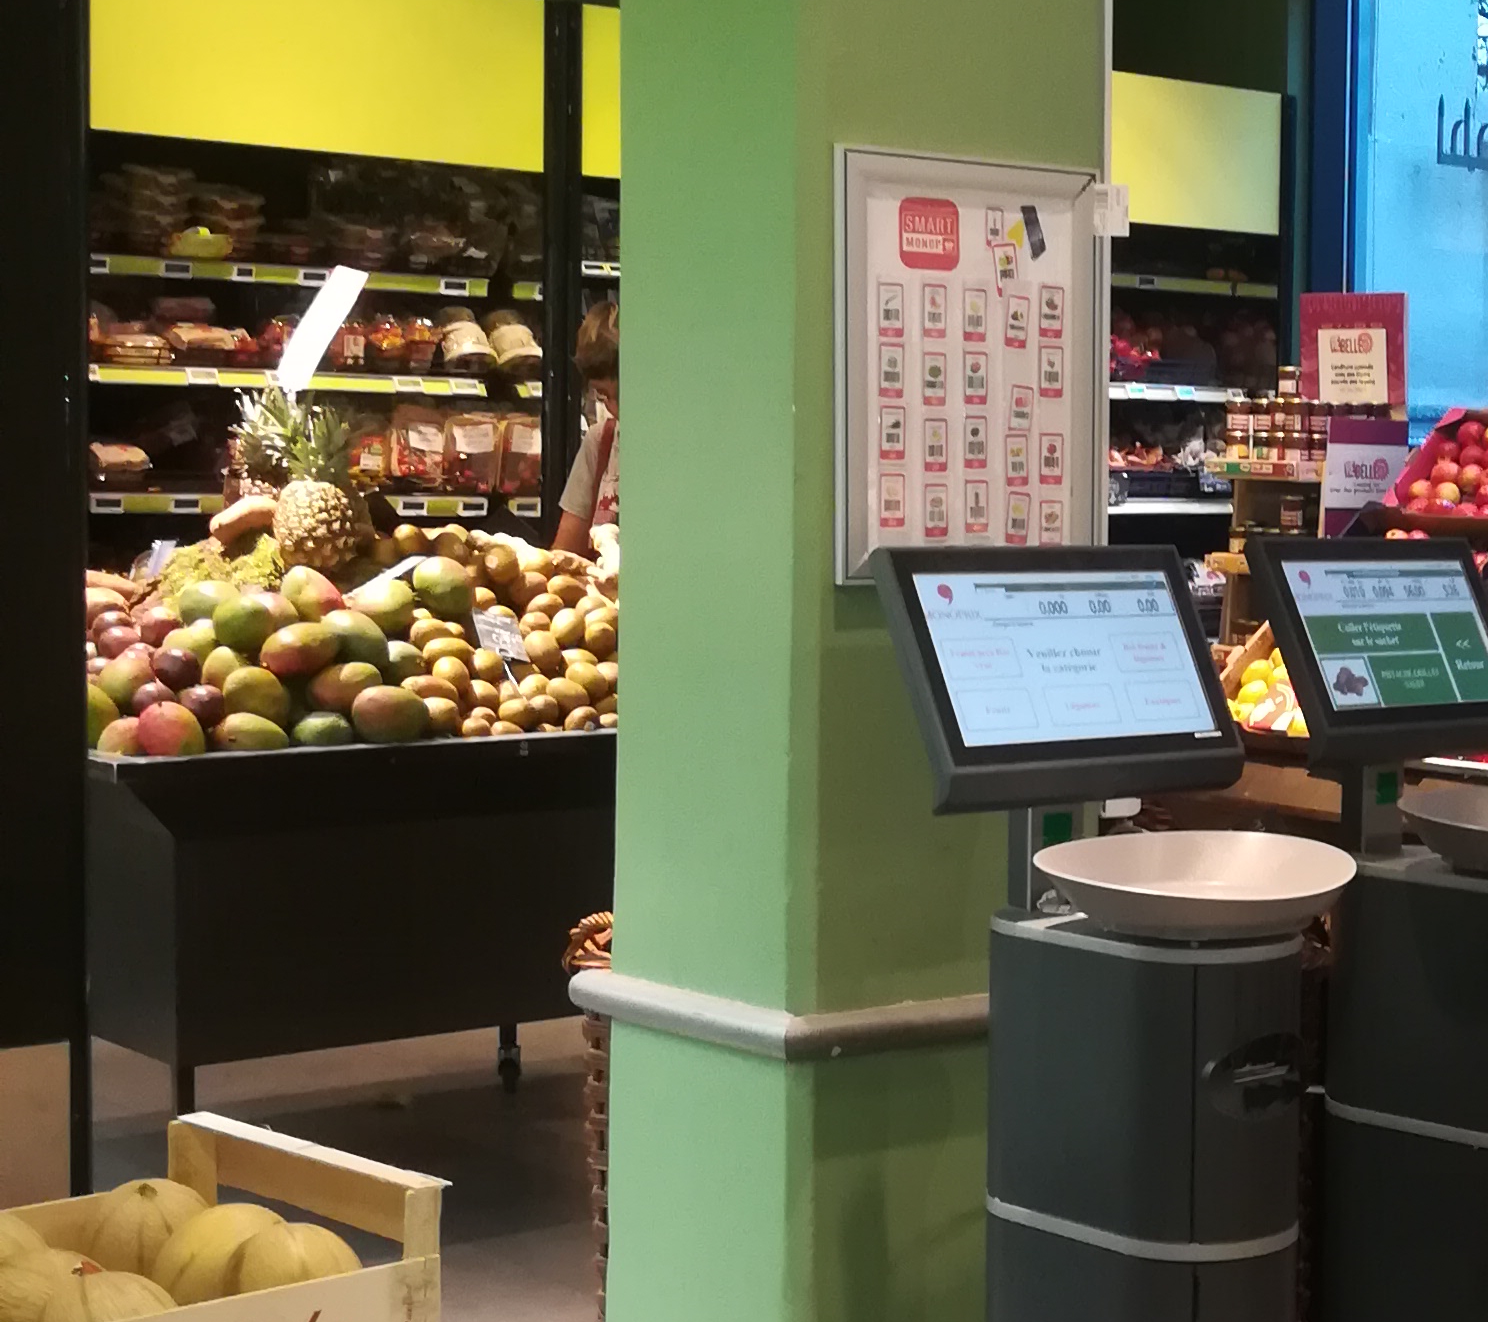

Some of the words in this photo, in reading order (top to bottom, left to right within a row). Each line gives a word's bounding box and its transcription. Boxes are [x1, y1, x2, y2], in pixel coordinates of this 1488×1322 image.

[905, 215, 953, 234] SMART
[1038, 600, 1068, 615] 0.000
[1089, 599, 1112, 614] 0.00
[1137, 597, 1160, 613] 0.00
[1455, 659, 1484, 671] Retour
